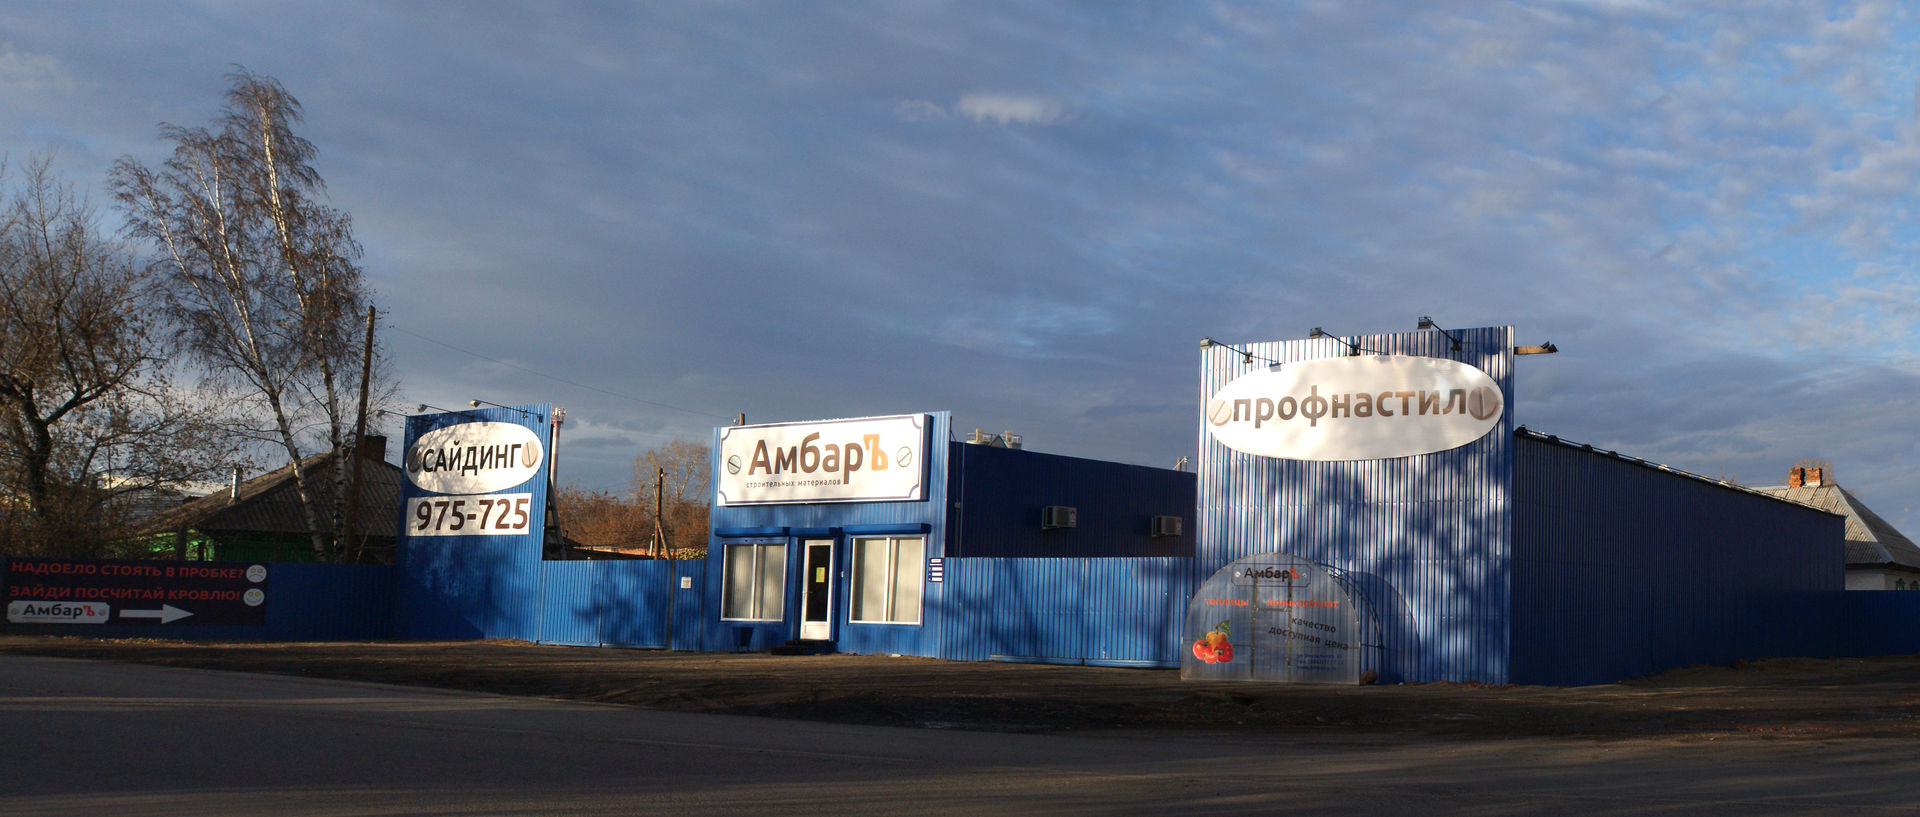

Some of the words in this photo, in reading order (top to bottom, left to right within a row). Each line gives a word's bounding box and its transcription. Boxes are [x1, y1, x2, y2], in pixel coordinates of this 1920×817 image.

[1232, 385, 1467, 429] профнастил
[422, 440, 522, 477] САЙДИНГ
[748, 431, 889, 485] АмбарЪ
[746, 480, 795, 489] строительных
[798, 478, 841, 487] материалов
[416, 498, 529, 531] 975-725
[11, 562, 97, 576] НАДОЕЛО
[100, 564, 162, 577] СТОЯТЬ
[165, 566, 176, 577] В
[179, 566, 244, 579] ПРОБКЕ?
[1244, 566, 1299, 582] АмбарЪ
[9, 584, 71, 599] ЗАЙДИ
[75, 586, 163, 600] ПОСЧИТАЙ
[168, 589, 241, 601] КРОВЛЮ!
[23, 603, 95, 619] АмбарЪ
[1205, 597, 1249, 607] теплицы
[1267, 598, 1339, 608] поликарбонат
[1291, 617, 1337, 633] качество
[1269, 626, 1321, 644] доступная
[1325, 640, 1348, 651] цена
